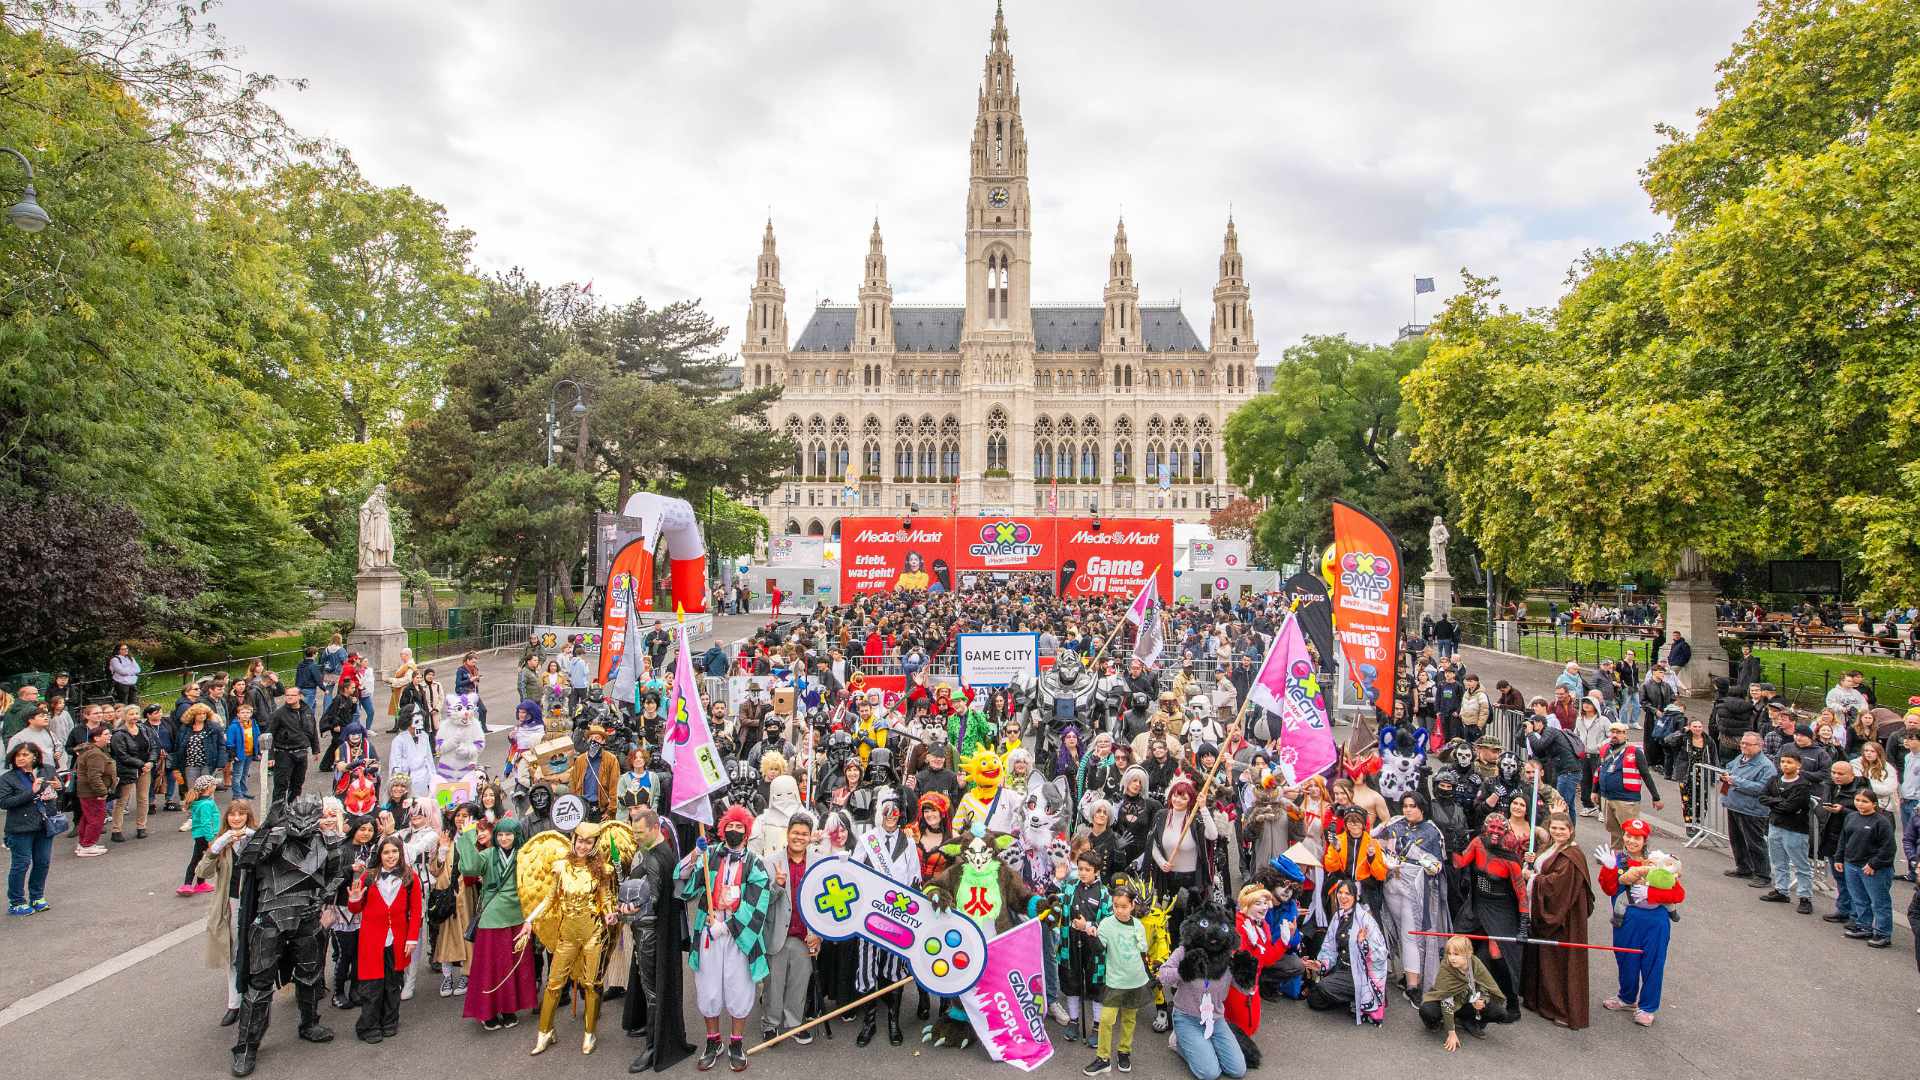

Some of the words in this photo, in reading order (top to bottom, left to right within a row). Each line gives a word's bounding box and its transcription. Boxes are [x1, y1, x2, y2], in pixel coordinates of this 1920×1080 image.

[1087, 556, 1144, 576] Game
[849, 568, 867, 577] was
[965, 650, 1001, 661] GAME
[1004, 649, 1032, 661] CITY
[556, 801, 579, 816] EA
[555, 814, 581, 824] SPORTS
